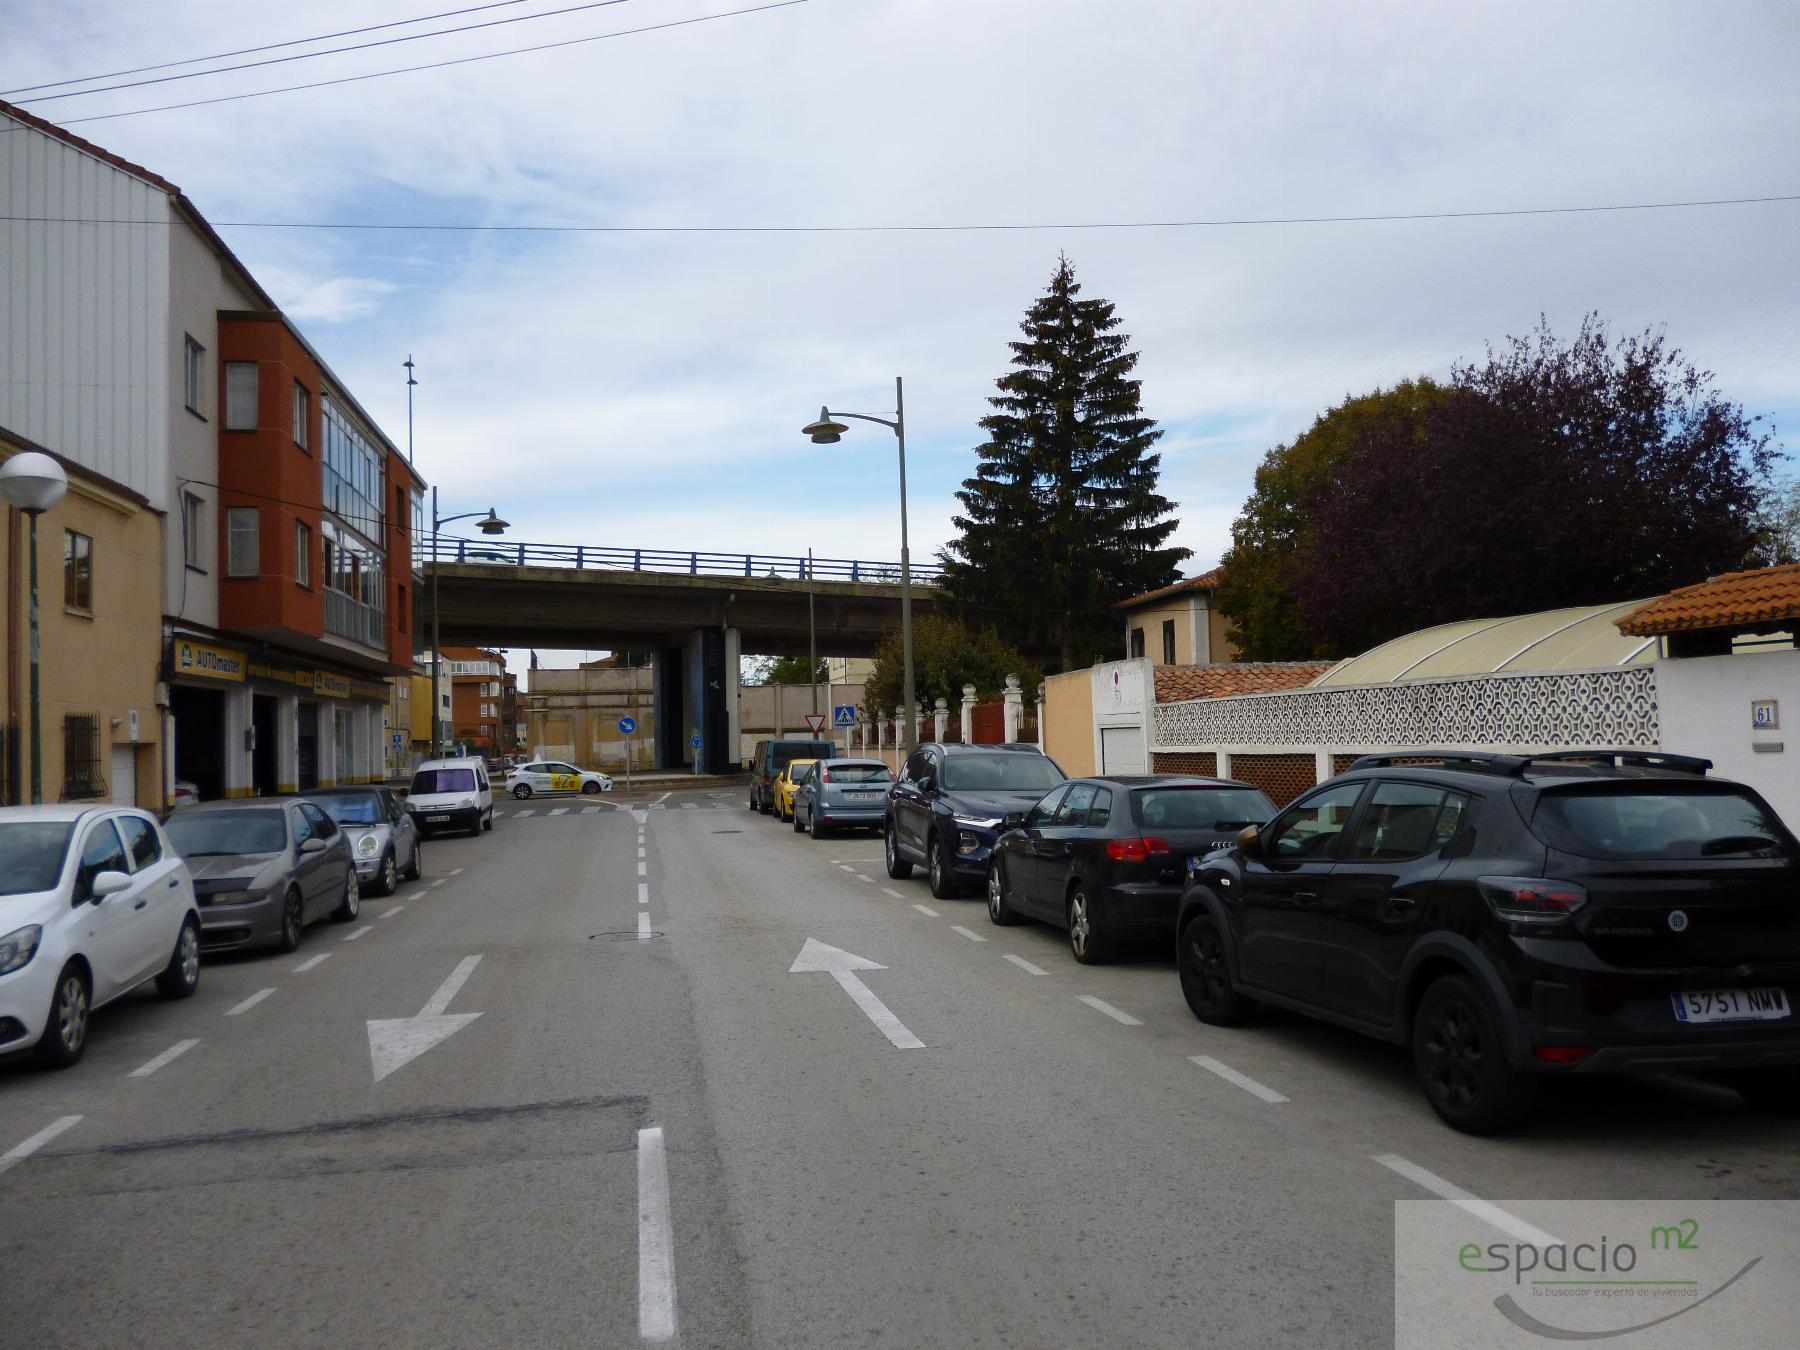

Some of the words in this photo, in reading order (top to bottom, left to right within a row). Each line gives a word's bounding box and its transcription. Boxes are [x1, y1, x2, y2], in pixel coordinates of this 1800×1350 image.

[197, 649, 241, 674] AUTOmaster
[1757, 707, 1772, 722] 61
[1594, 927, 1654, 936] SANDERO
[1690, 992, 1739, 1015] 5751
[1747, 989, 1785, 1012] NMW
